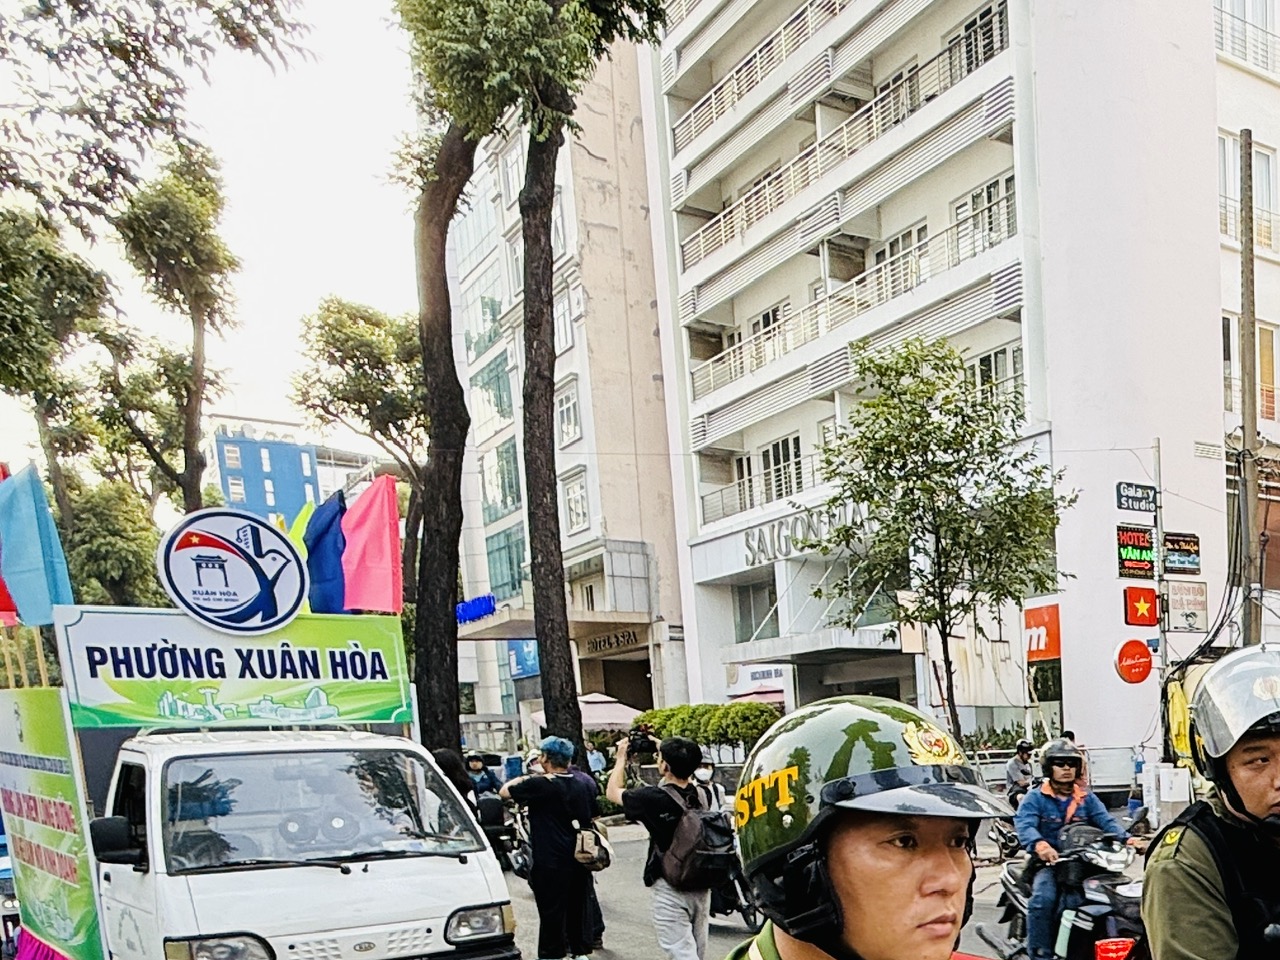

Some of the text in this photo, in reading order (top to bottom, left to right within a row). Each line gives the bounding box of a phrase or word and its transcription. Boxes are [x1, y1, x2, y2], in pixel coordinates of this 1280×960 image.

[1120, 483, 1154, 501] Galaxy
[1121, 497, 1155, 511] Studio
[744, 509, 823, 567] SAIGON
[1119, 531, 1150, 546] HOTEL
[86, 638, 389, 680] PHƯỜNG XUÂN HÒA
